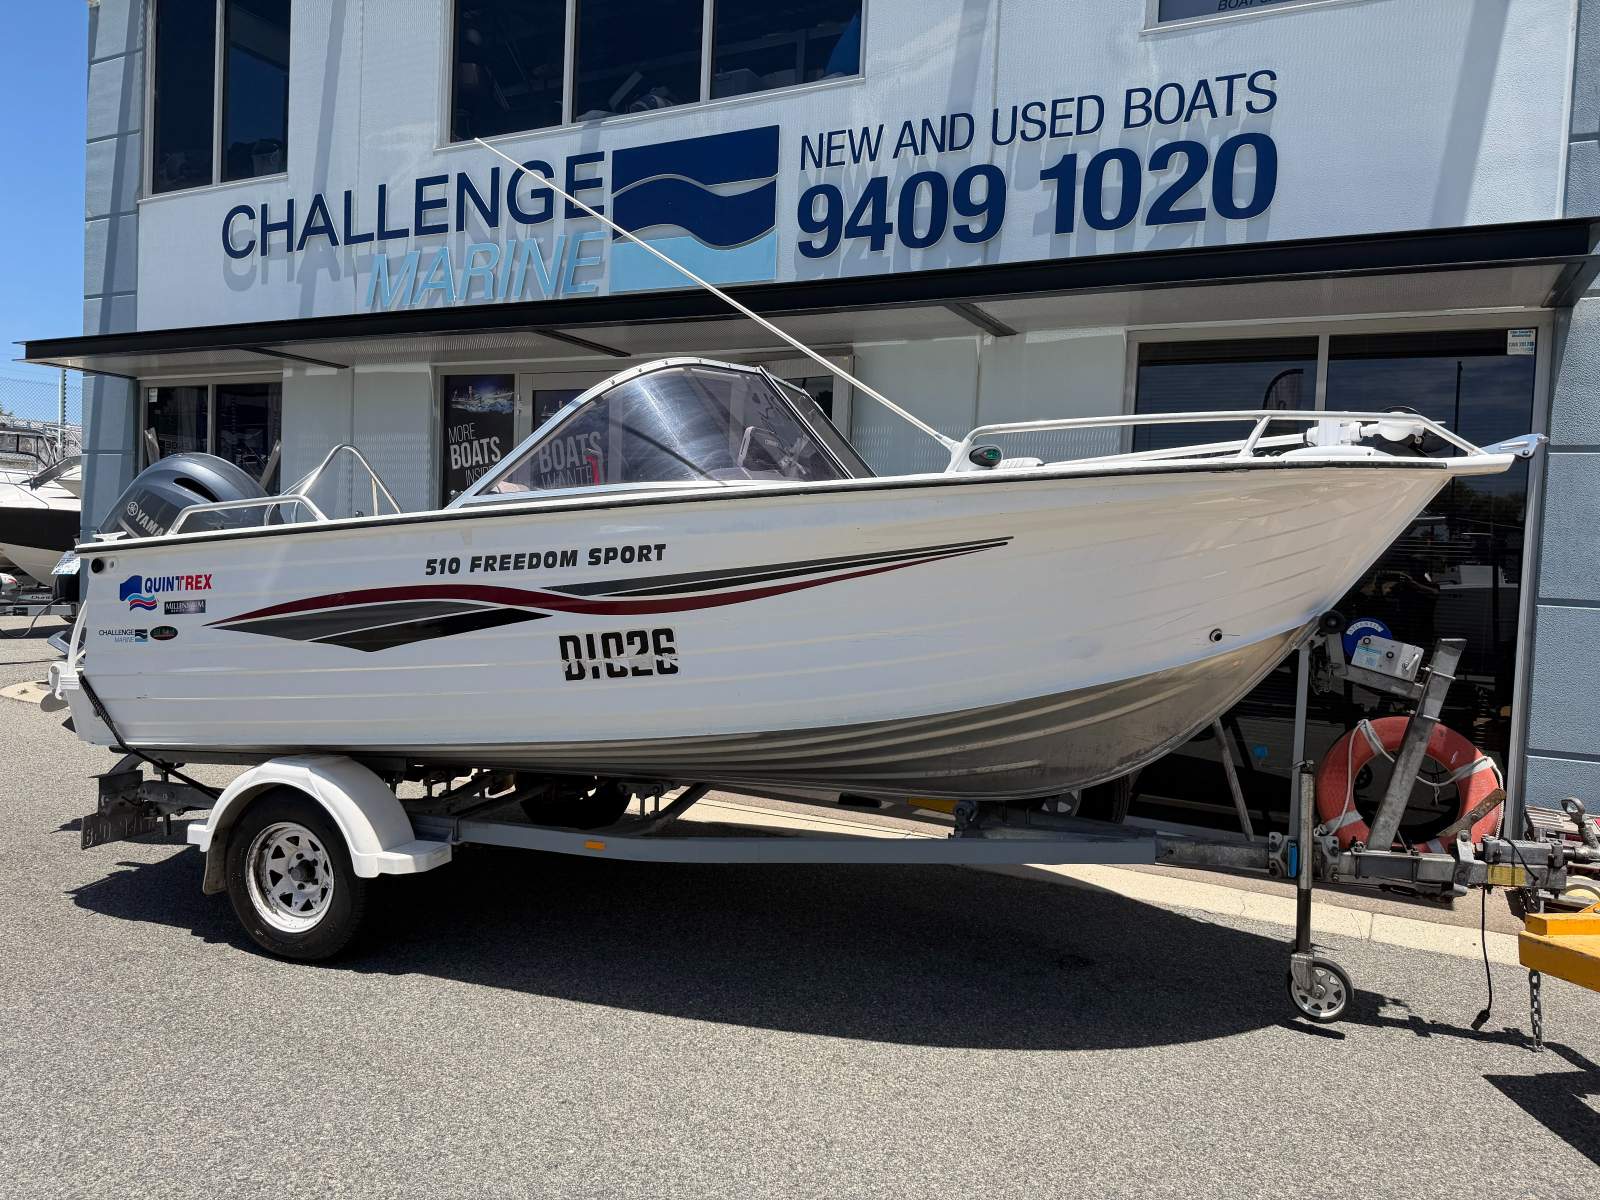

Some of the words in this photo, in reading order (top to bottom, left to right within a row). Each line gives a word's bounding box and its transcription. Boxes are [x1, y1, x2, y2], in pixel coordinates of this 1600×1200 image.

[800, 124, 885, 170] NEW
[892, 113, 976, 158] AND
[990, 94, 1105, 146] USED
[1124, 69, 1278, 129] BOATS
[221, 151, 605, 259] CHALLENGE
[796, 164, 1007, 259] 9409
[1039, 132, 1278, 235] 1020
[366, 231, 608, 307] MARINE
[449, 422, 475, 444] MORE
[450, 436, 501, 470] BOATS
[539, 431, 603, 473] BOATS
[464, 464, 495, 487] INSI
[540, 465, 594, 490] WANTE
[135, 508, 165, 537] YAMA
[425, 557, 461, 576] 510
[469, 549, 578, 573] FREEDOM
[587, 543, 667, 566] SPORT
[144, 574, 213, 593] QUINTREX
[98, 628, 135, 636] CHALLENGE
